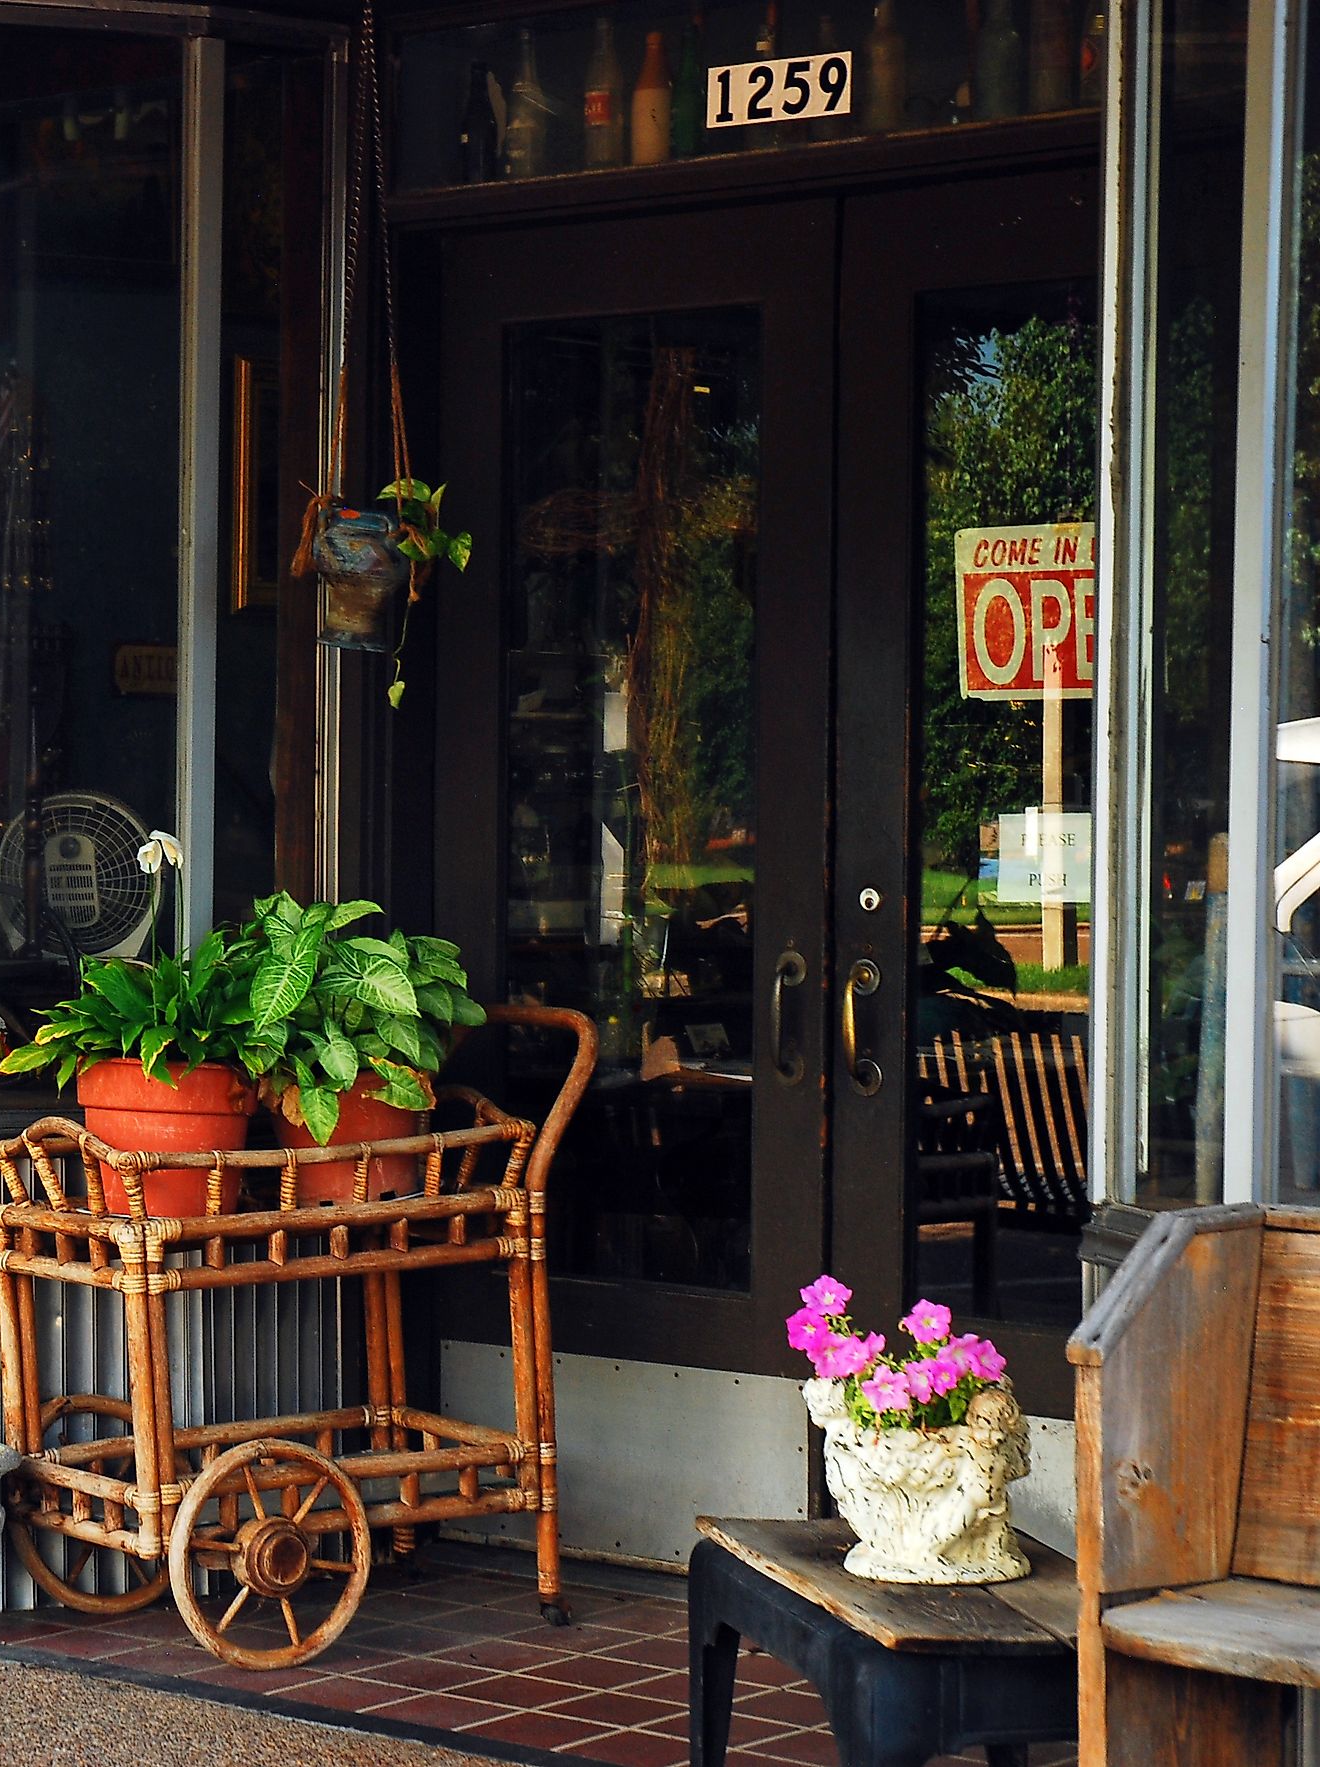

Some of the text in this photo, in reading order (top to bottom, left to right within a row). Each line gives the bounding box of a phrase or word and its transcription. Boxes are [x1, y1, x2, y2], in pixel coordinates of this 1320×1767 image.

[716, 57, 847, 122] 1259
[973, 538, 1043, 567] COME
[1054, 536, 1078, 565] IN
